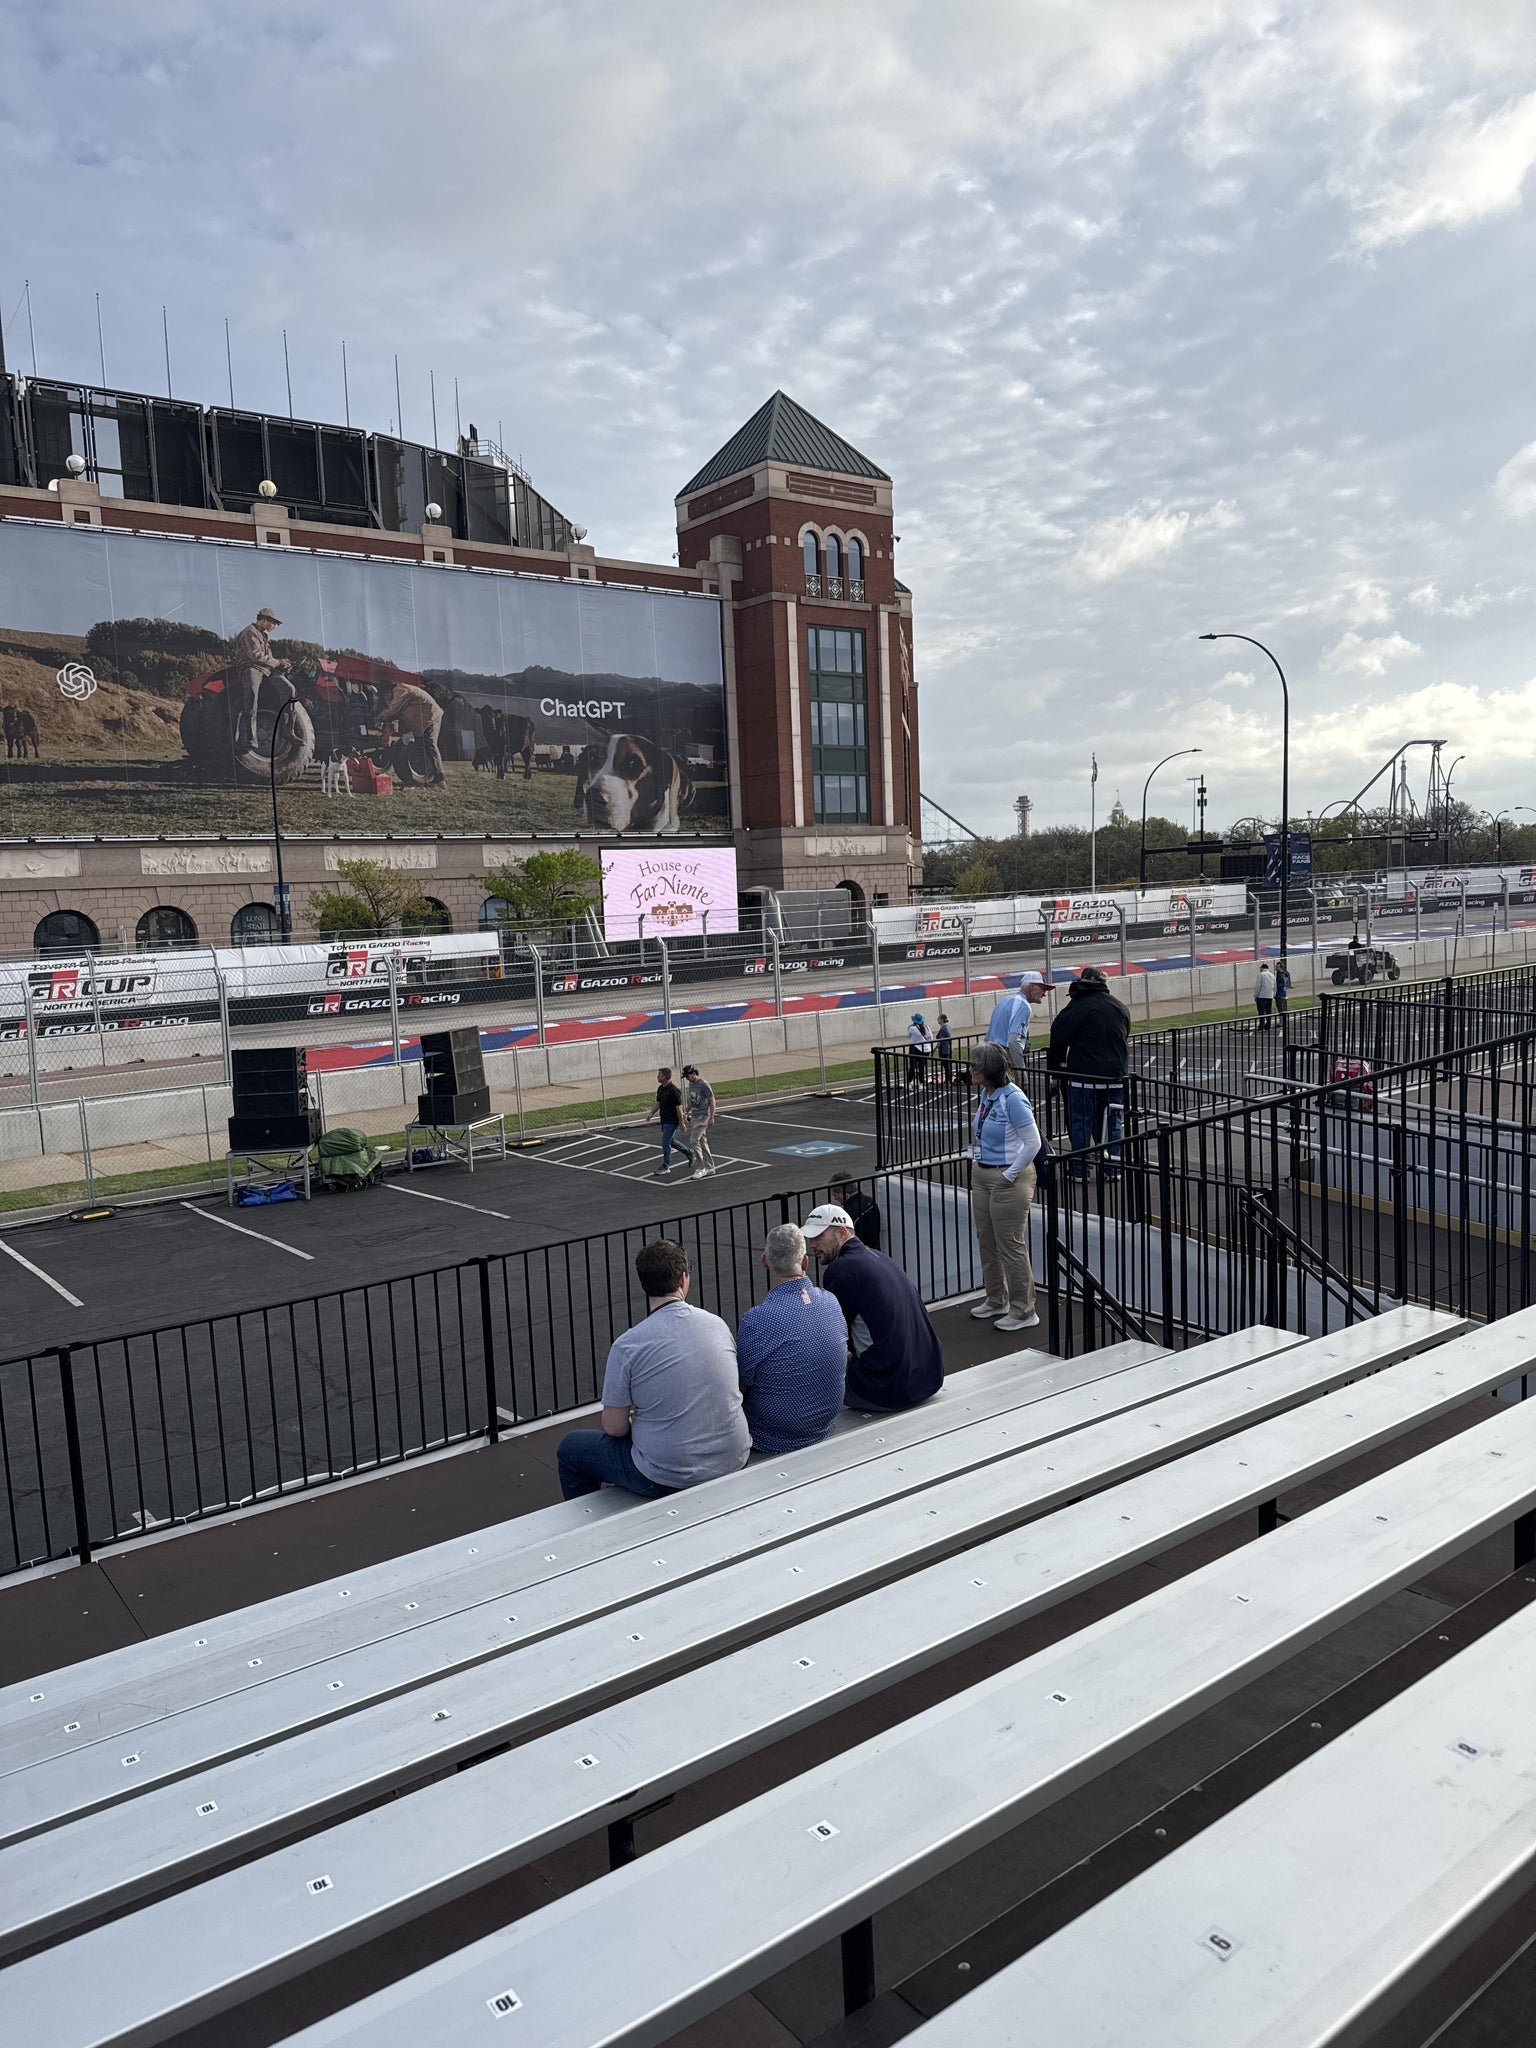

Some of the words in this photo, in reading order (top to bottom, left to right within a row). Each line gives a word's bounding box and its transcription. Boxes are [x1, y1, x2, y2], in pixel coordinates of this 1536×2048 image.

[540, 697, 626, 719] ChatGPT
[638, 861, 682, 877] House
[684, 863, 701, 876] of
[630, 883, 658, 909] Far
[658, 873, 714, 905] Niente
[1072, 899, 1115, 910] GAZOO
[1170, 901, 1187, 911] GR
[1071, 909, 1114, 922] Racing
[941, 916, 974, 930] CUP
[1205, 921, 1230, 930] Racing
[1062, 935, 1091, 943] GAZOO
[1091, 931, 1118, 941] Racing
[330, 943, 367, 952] TOYOTA
[368, 941, 401, 949] GAZOO
[402, 939, 431, 947] Racing
[907, 949, 925, 958] GR
[926, 947, 960, 956] GAZOO
[327, 960, 367, 978] GR
[743, 964, 764, 974] GR
[809, 957, 845, 967] Racing
[340, 976, 372, 987] NORTH
[552, 980, 577, 991] GR
[580, 977, 628, 989] GAZOO
[31, 981, 77, 1000] GR
[81, 976, 151, 996] CUP
[43, 1002, 84, 1011] NORTH
[309, 1002, 340, 1014] GR
[344, 998, 405, 1011] GAZOO
[407, 992, 461, 1004] Racing
[43, 1022, 120, 1037] GAZOO
[123, 1016, 190, 1030] Racing
[1052, 1694, 1065, 1702] 8
[1458, 1743, 1478, 1755] 8
[126, 1756, 135, 1764] 10
[582, 1758, 592, 1766] 9
[201, 1804, 213, 1813] 10
[817, 1826, 830, 1836] 9
[312, 1879, 328, 1891] 10
[1209, 1934, 1232, 1950] 9
[495, 1995, 516, 2011] 10
